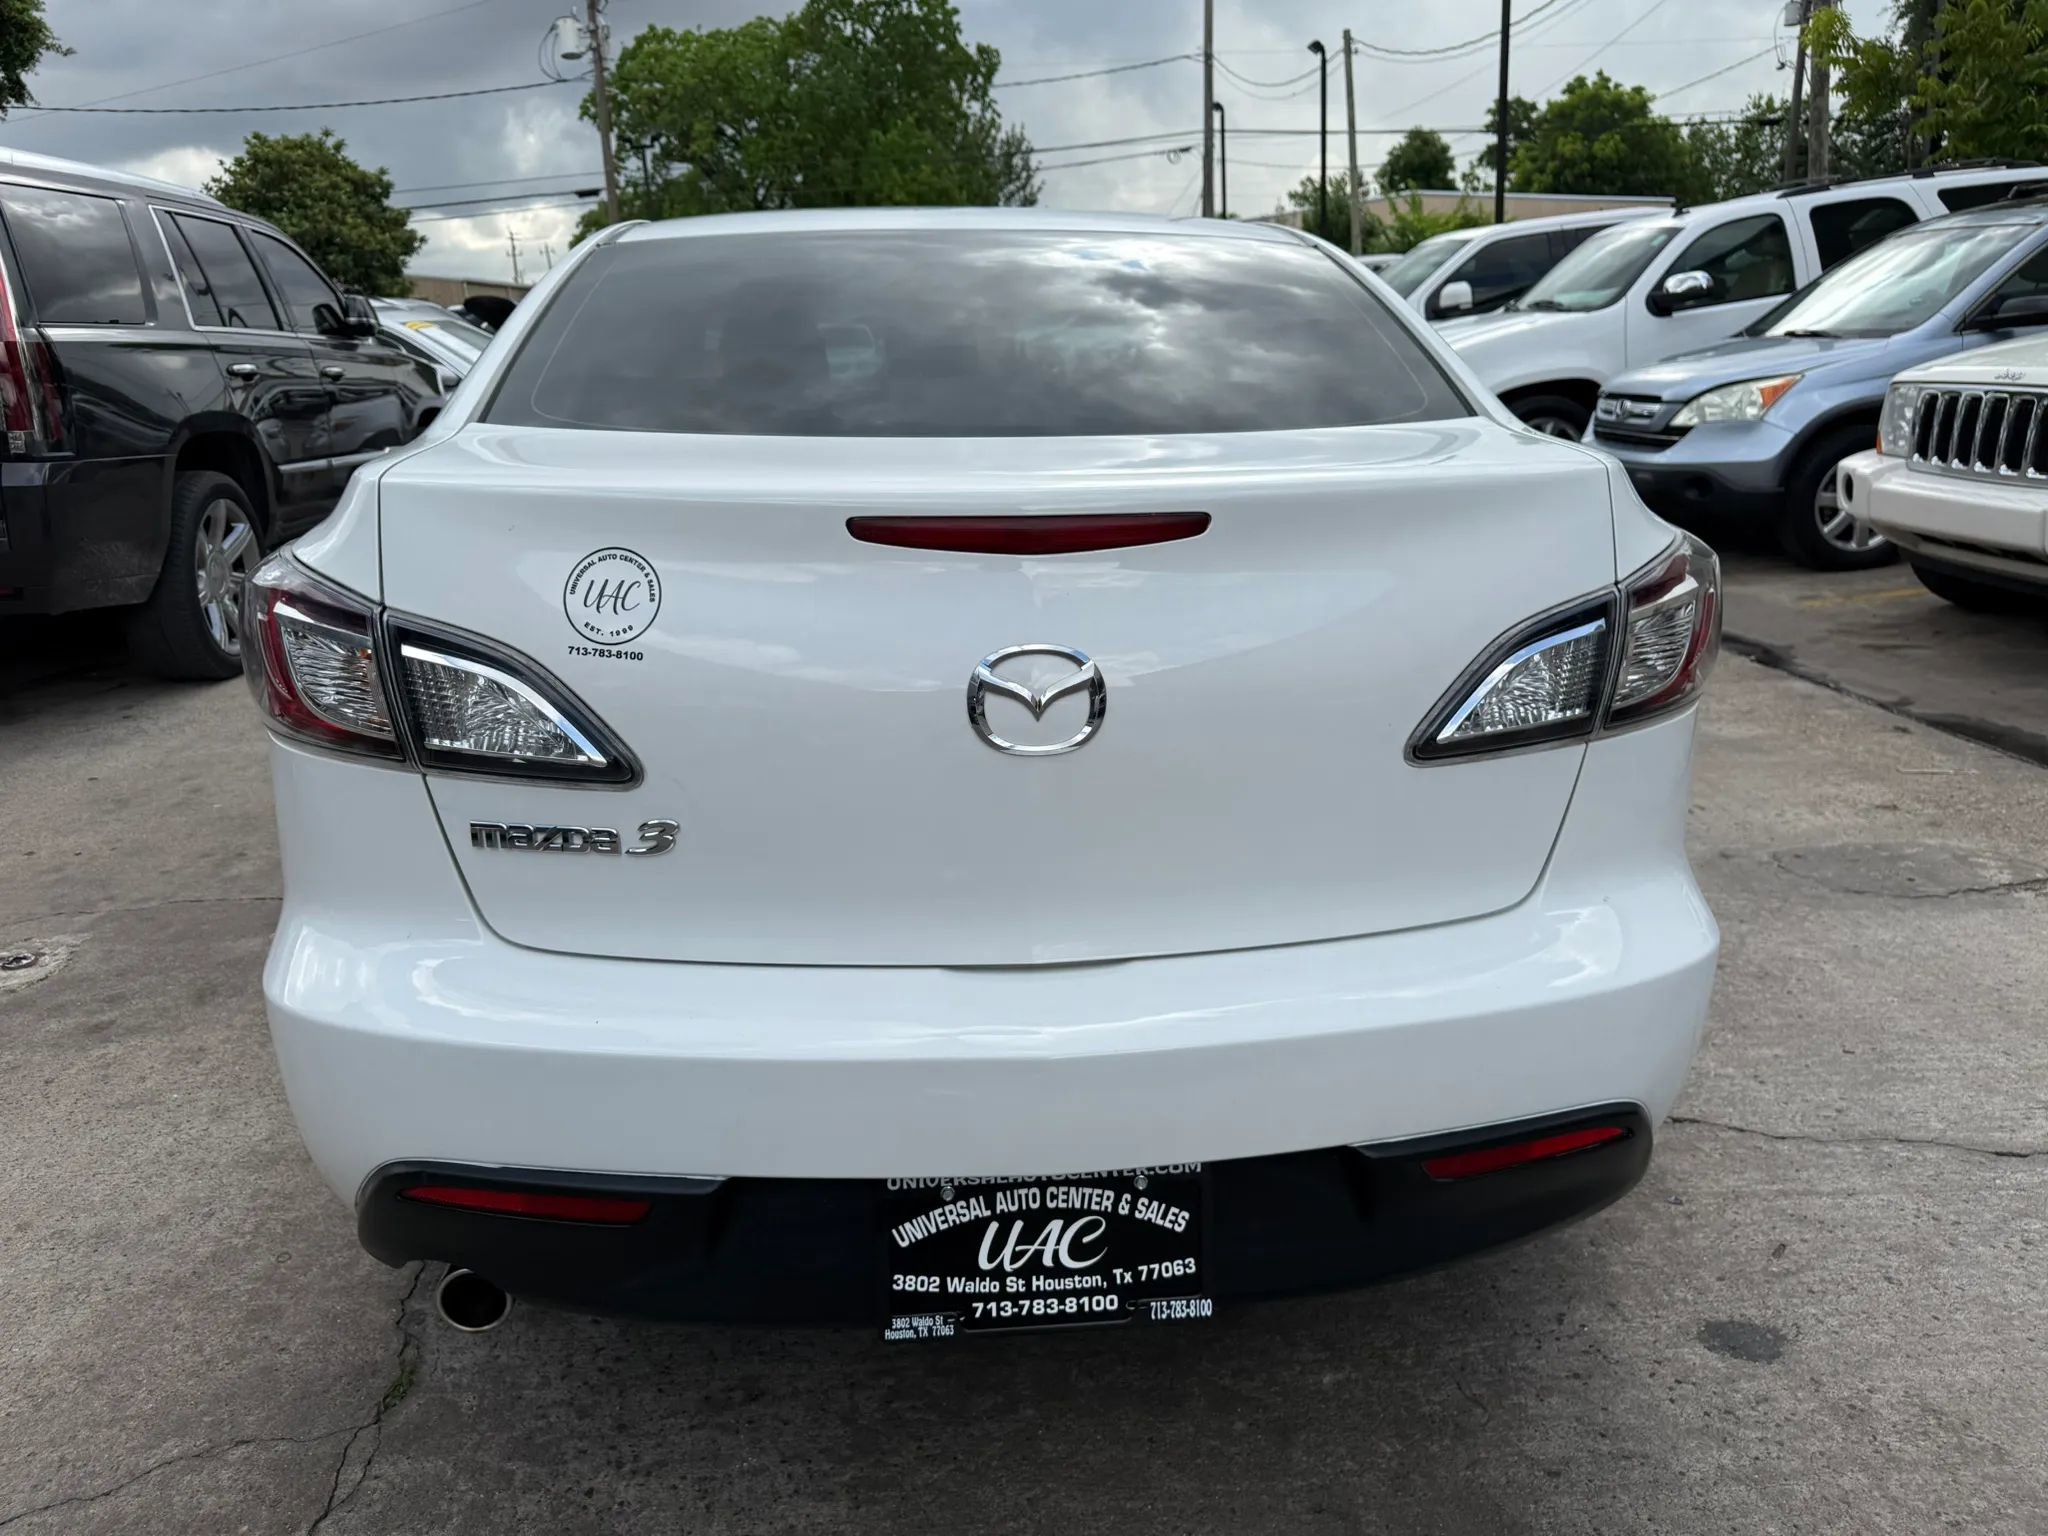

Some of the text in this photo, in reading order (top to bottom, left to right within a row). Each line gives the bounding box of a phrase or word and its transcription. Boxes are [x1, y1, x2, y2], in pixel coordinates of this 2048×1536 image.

[569, 560, 597, 595] UNIVERSAL
[598, 553, 617, 562] AUTO
[619, 554, 646, 573] CENTER
[647, 579, 656, 602] SALES
[583, 578, 641, 615] UAC
[584, 621, 604, 636] EST.
[568, 646, 644, 661] 713-783-8100
[624, 819, 680, 857] 3
[892, 1186, 1190, 1248] UNIVERSAL AUTO CENTER & SALES
[978, 1215, 1108, 1272] UAC
[892, 1258, 1197, 1293] 3802 Waldo St Houston, Tx 77063
[972, 1295, 1119, 1319] 713-783-8100
[1150, 1299, 1212, 1320] 713-783-8100
[892, 1315, 944, 1329] 3802 Waldo St
[918, 1326, 929, 1337] TX
[932, 1324, 955, 1336] 77063
